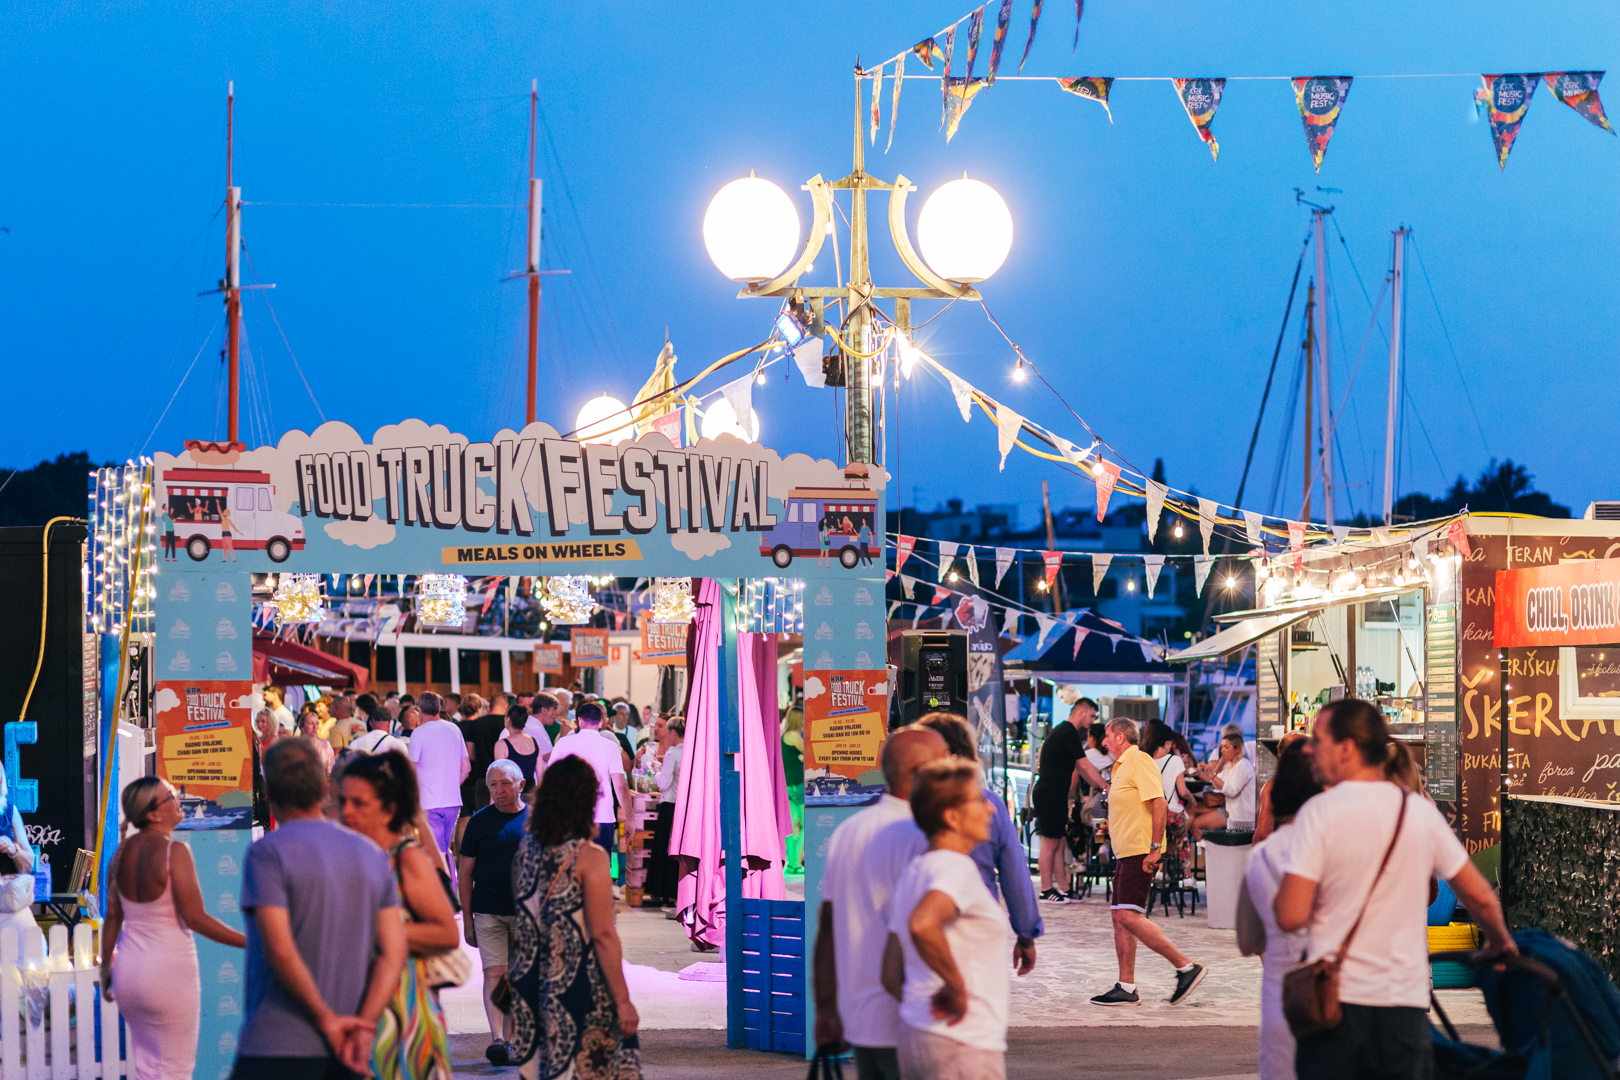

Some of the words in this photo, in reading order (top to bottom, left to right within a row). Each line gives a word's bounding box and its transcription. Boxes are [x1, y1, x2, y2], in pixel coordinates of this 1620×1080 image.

[1311, 85, 1326, 93] KRK
[1563, 82, 1579, 90] KRK
[1187, 94, 1210, 102] MUSIC
[1310, 92, 1335, 100] MUSIC
[1497, 97, 1516, 106] FEST
[1498, 90, 1523, 98] MUSIC
[1310, 100, 1328, 109] FEST
[295, 449, 373, 522] FOOD
[377, 438, 537, 537] TRUCK
[540, 437, 778, 537] FESTIVAL
[457, 547, 519, 562] MEALS
[523, 546, 547, 560] ON
[551, 543, 626, 559] WHEELS
[1506, 545, 1553, 566] TERAN
[1526, 586, 1569, 634] CHILL,
[1570, 581, 1614, 630] DRINK
[660, 623, 687, 638] TRUCK
[647, 634, 687, 649] FESTIVAL
[830, 682, 842, 694] FOOD
[842, 680, 865, 696] TRUCK
[186, 694, 199, 706] FOOD
[200, 692, 227, 709] TRUCK
[831, 693, 864, 707] FESTIVAL
[187, 705, 226, 722] FESTIVAL
